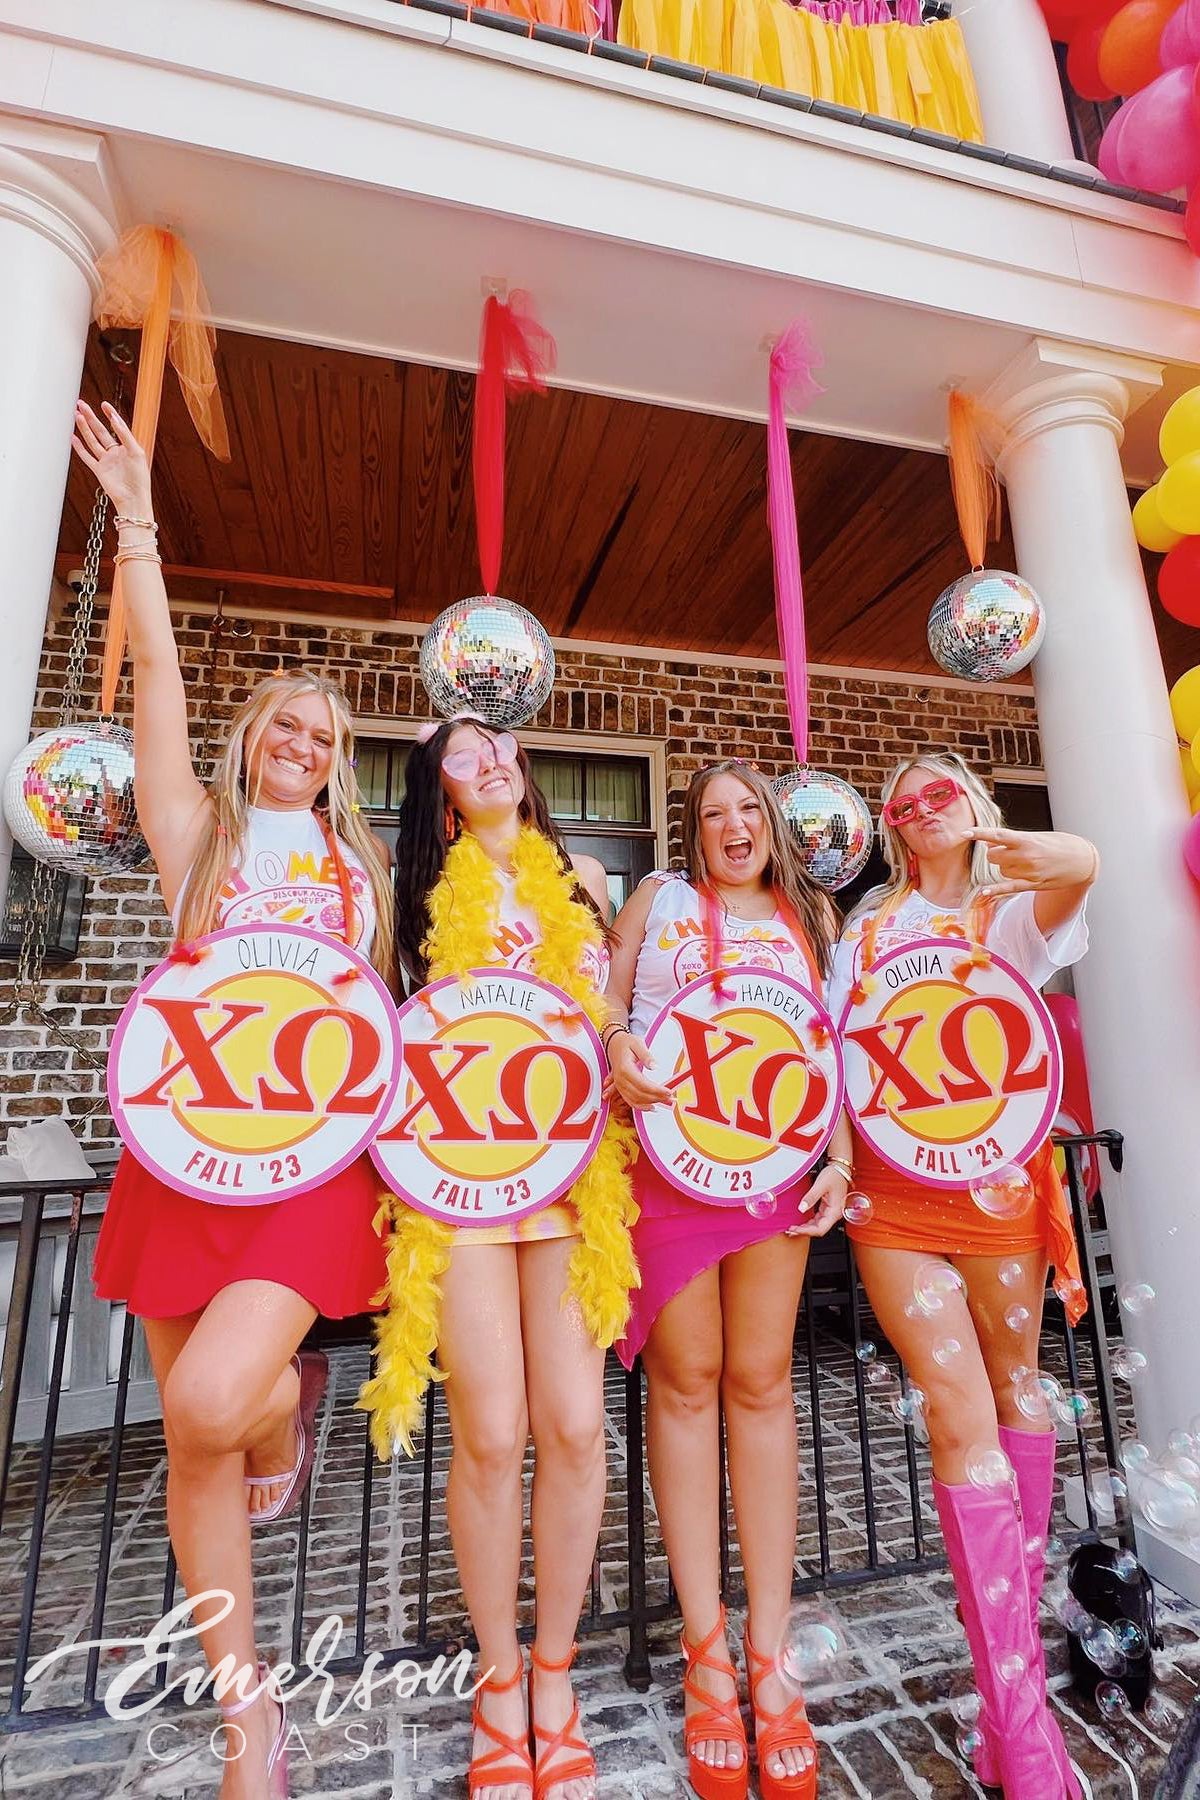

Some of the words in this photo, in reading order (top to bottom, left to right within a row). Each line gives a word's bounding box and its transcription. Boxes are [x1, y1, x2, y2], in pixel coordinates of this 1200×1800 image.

[298, 897, 328, 905] NEVER
[237, 936, 320, 977] OLIVIA
[681, 962, 702, 970] XOXO
[885, 953, 944, 989] OLIVIA
[459, 983, 537, 1012] NATALIE
[741, 984, 805, 1022] HAYDEN
[183, 1150, 244, 1188] FALL
[260, 1154, 302, 1185] '23
[672, 1149, 714, 1188] FALL
[724, 1169, 754, 1192] '23
[914, 1145, 962, 1175] FALL
[967, 1136, 1004, 1167] '23
[431, 1178, 483, 1211] FALL
[495, 1178, 532, 1207] '23
